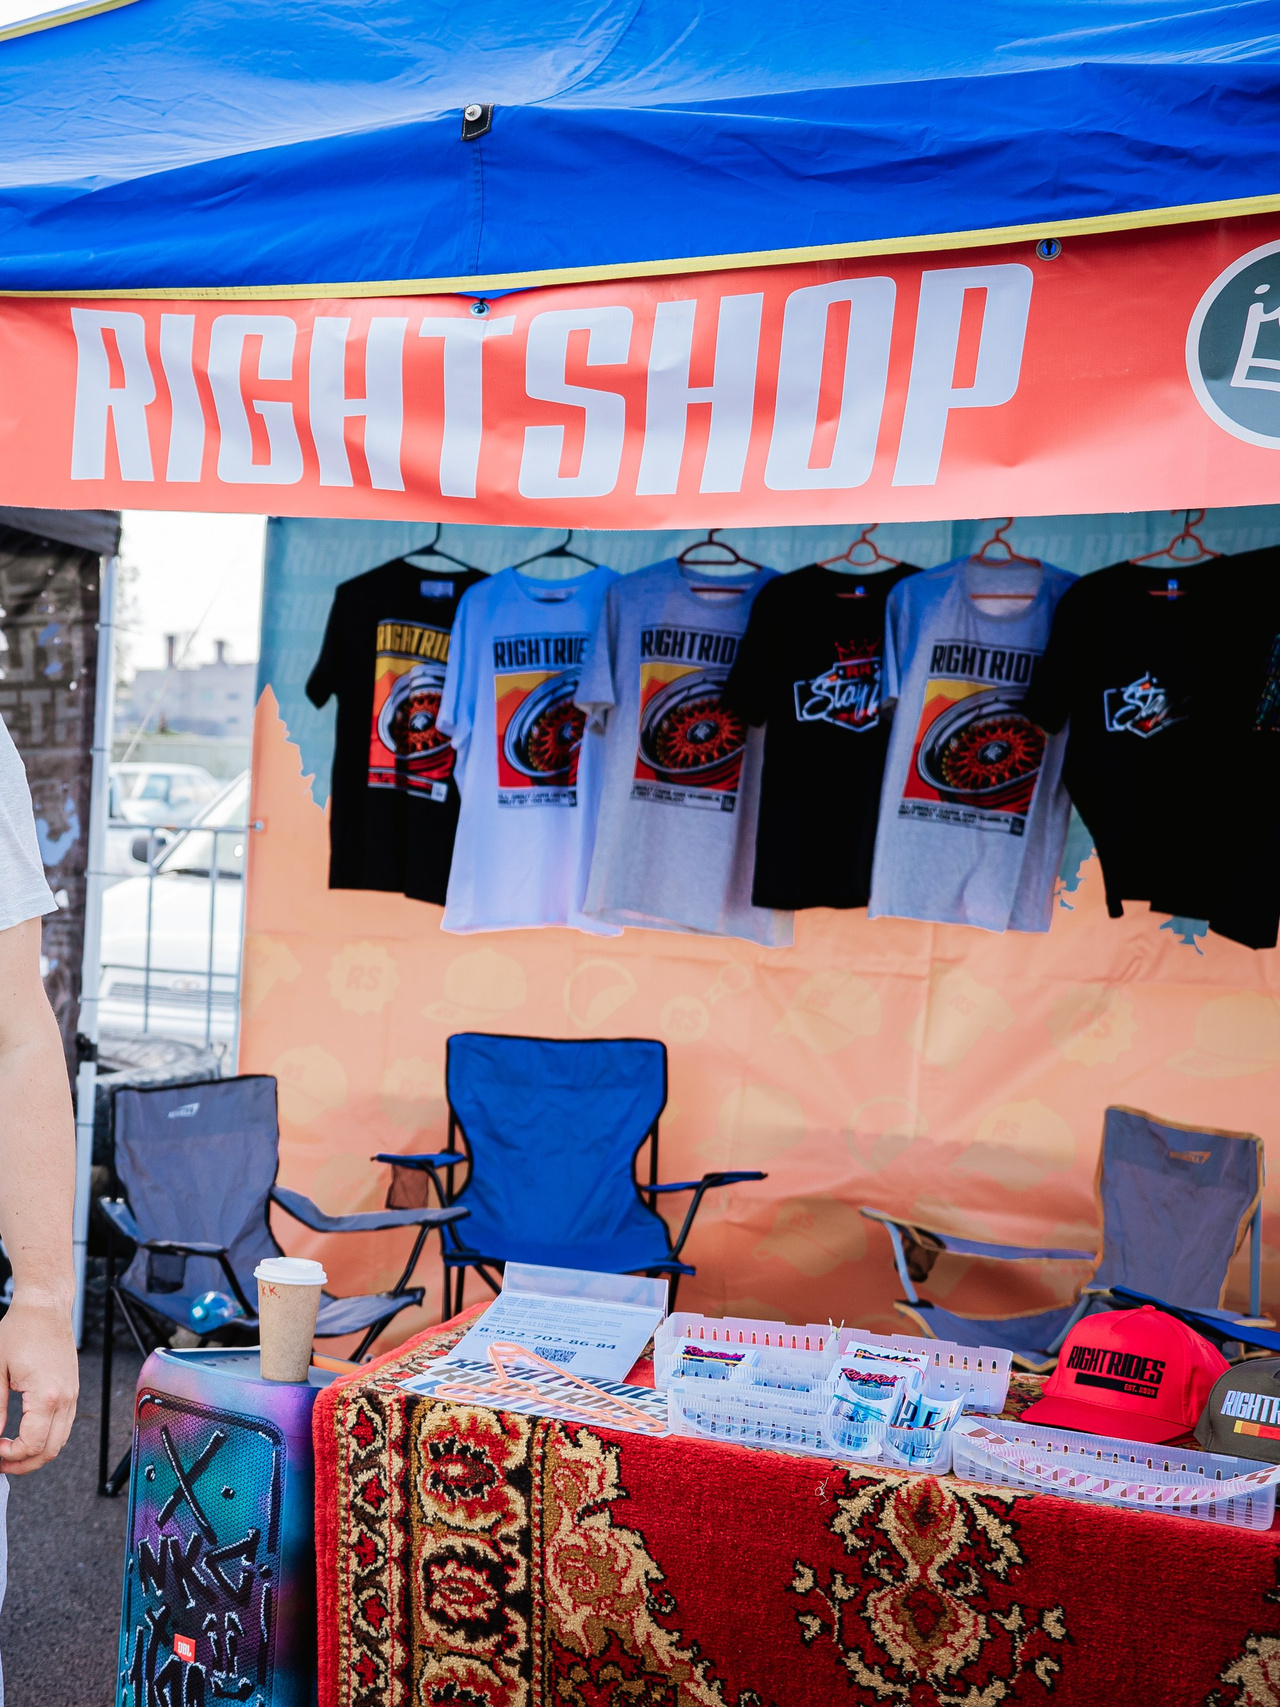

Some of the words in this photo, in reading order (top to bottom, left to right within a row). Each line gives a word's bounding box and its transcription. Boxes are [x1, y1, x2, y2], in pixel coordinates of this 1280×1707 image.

[71, 262, 1035, 500] RIGHTSHOP
[479, 1326, 618, 1351] 8-922-702-86-84
[1066, 1344, 1167, 1386] RIGHTRIDES
